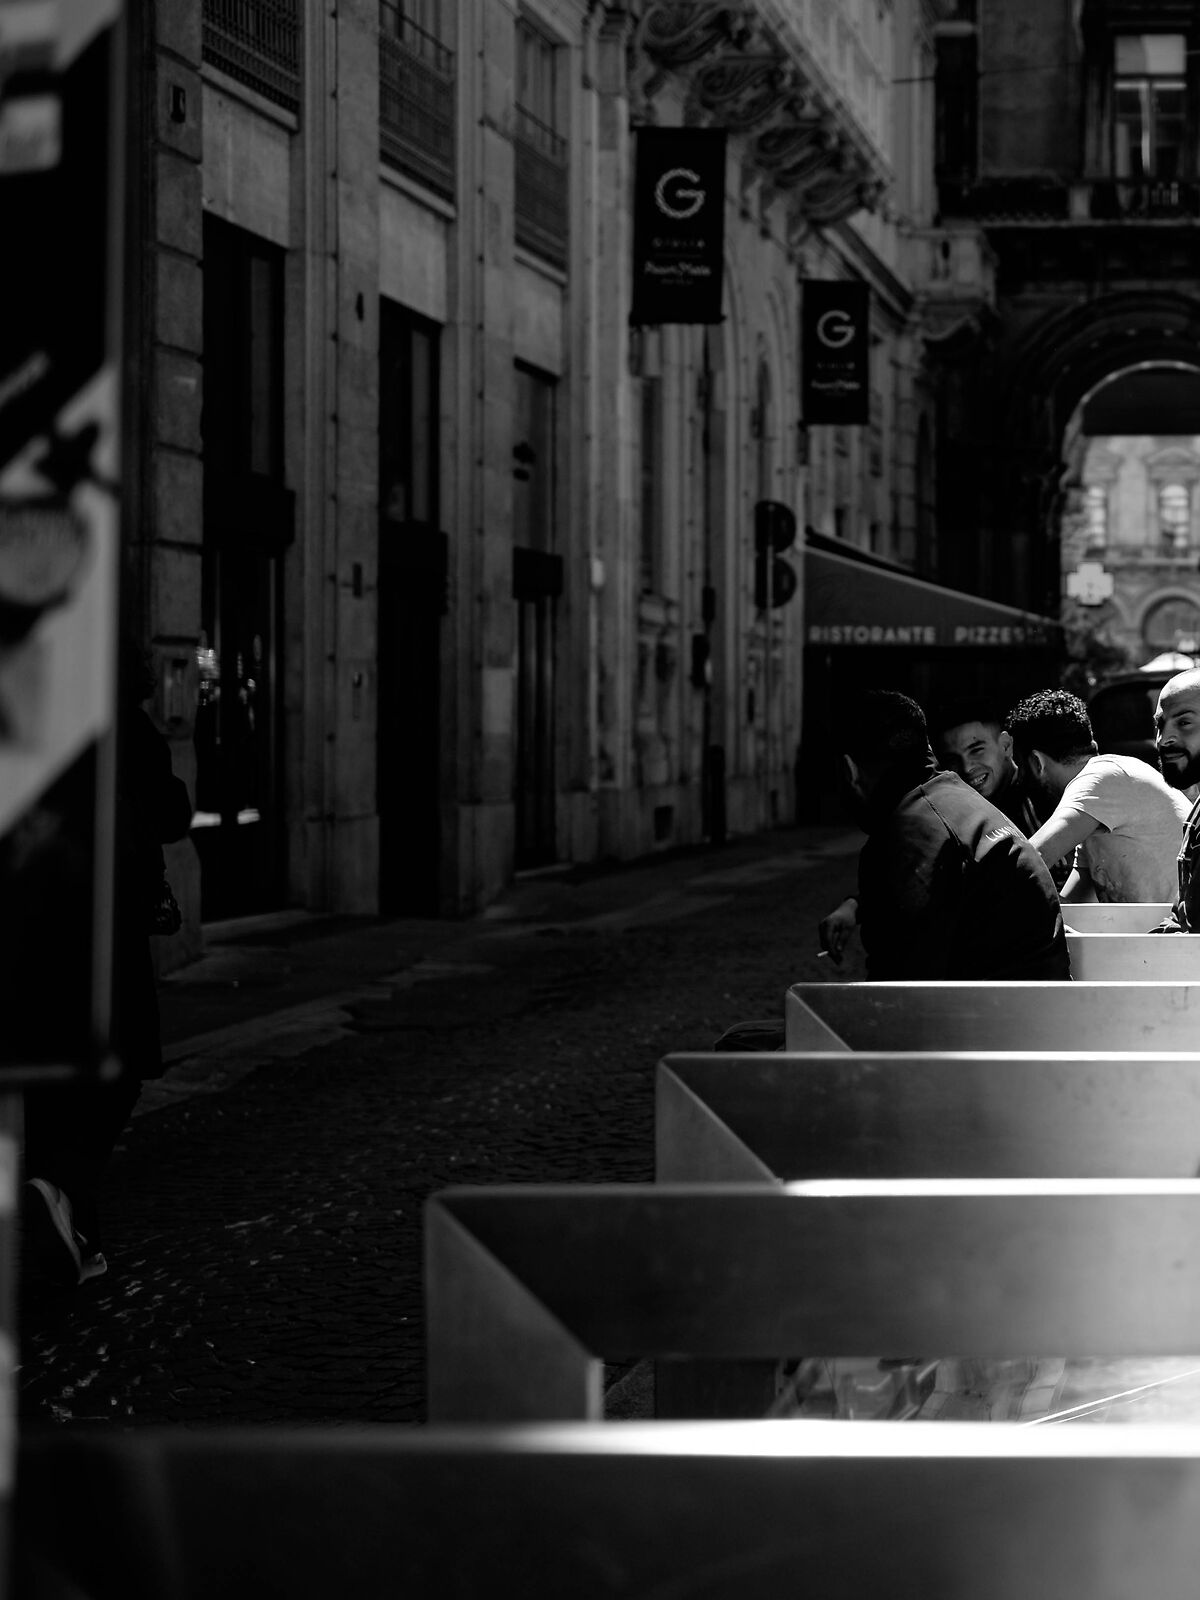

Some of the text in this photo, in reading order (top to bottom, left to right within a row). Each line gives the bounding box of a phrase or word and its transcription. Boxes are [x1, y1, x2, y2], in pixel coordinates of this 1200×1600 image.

[655, 168, 705, 219] G
[817, 310, 855, 348] G
[808, 626, 935, 644] RISTORANTE
